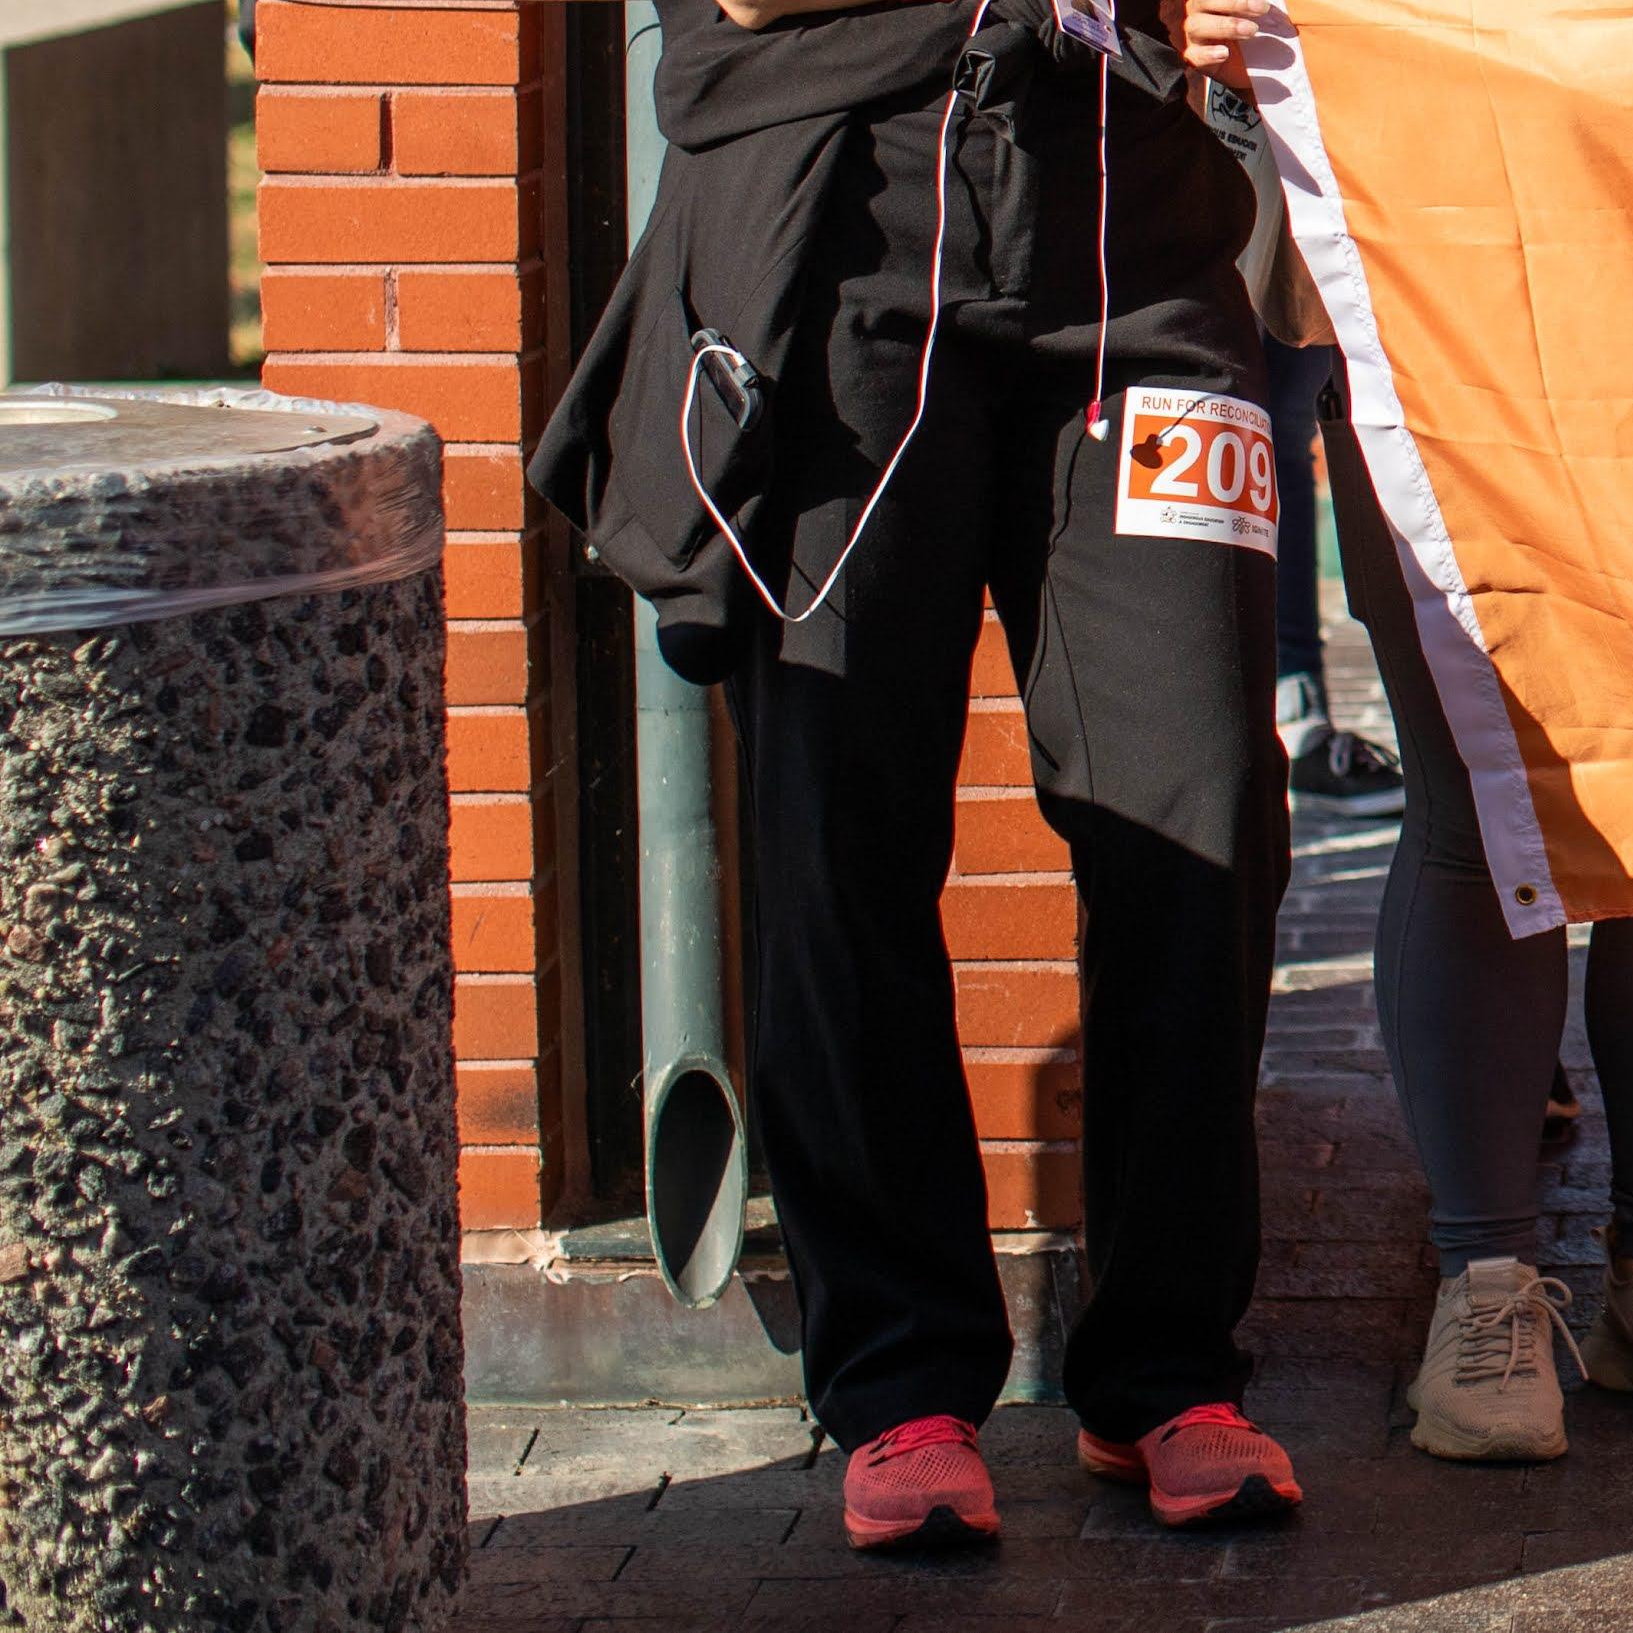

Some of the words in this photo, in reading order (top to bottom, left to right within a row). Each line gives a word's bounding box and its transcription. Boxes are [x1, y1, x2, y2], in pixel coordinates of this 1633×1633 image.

[1141, 396, 1172, 411] RUN
[1177, 398, 1206, 414] FOR
[1150, 424, 1272, 511] 209
